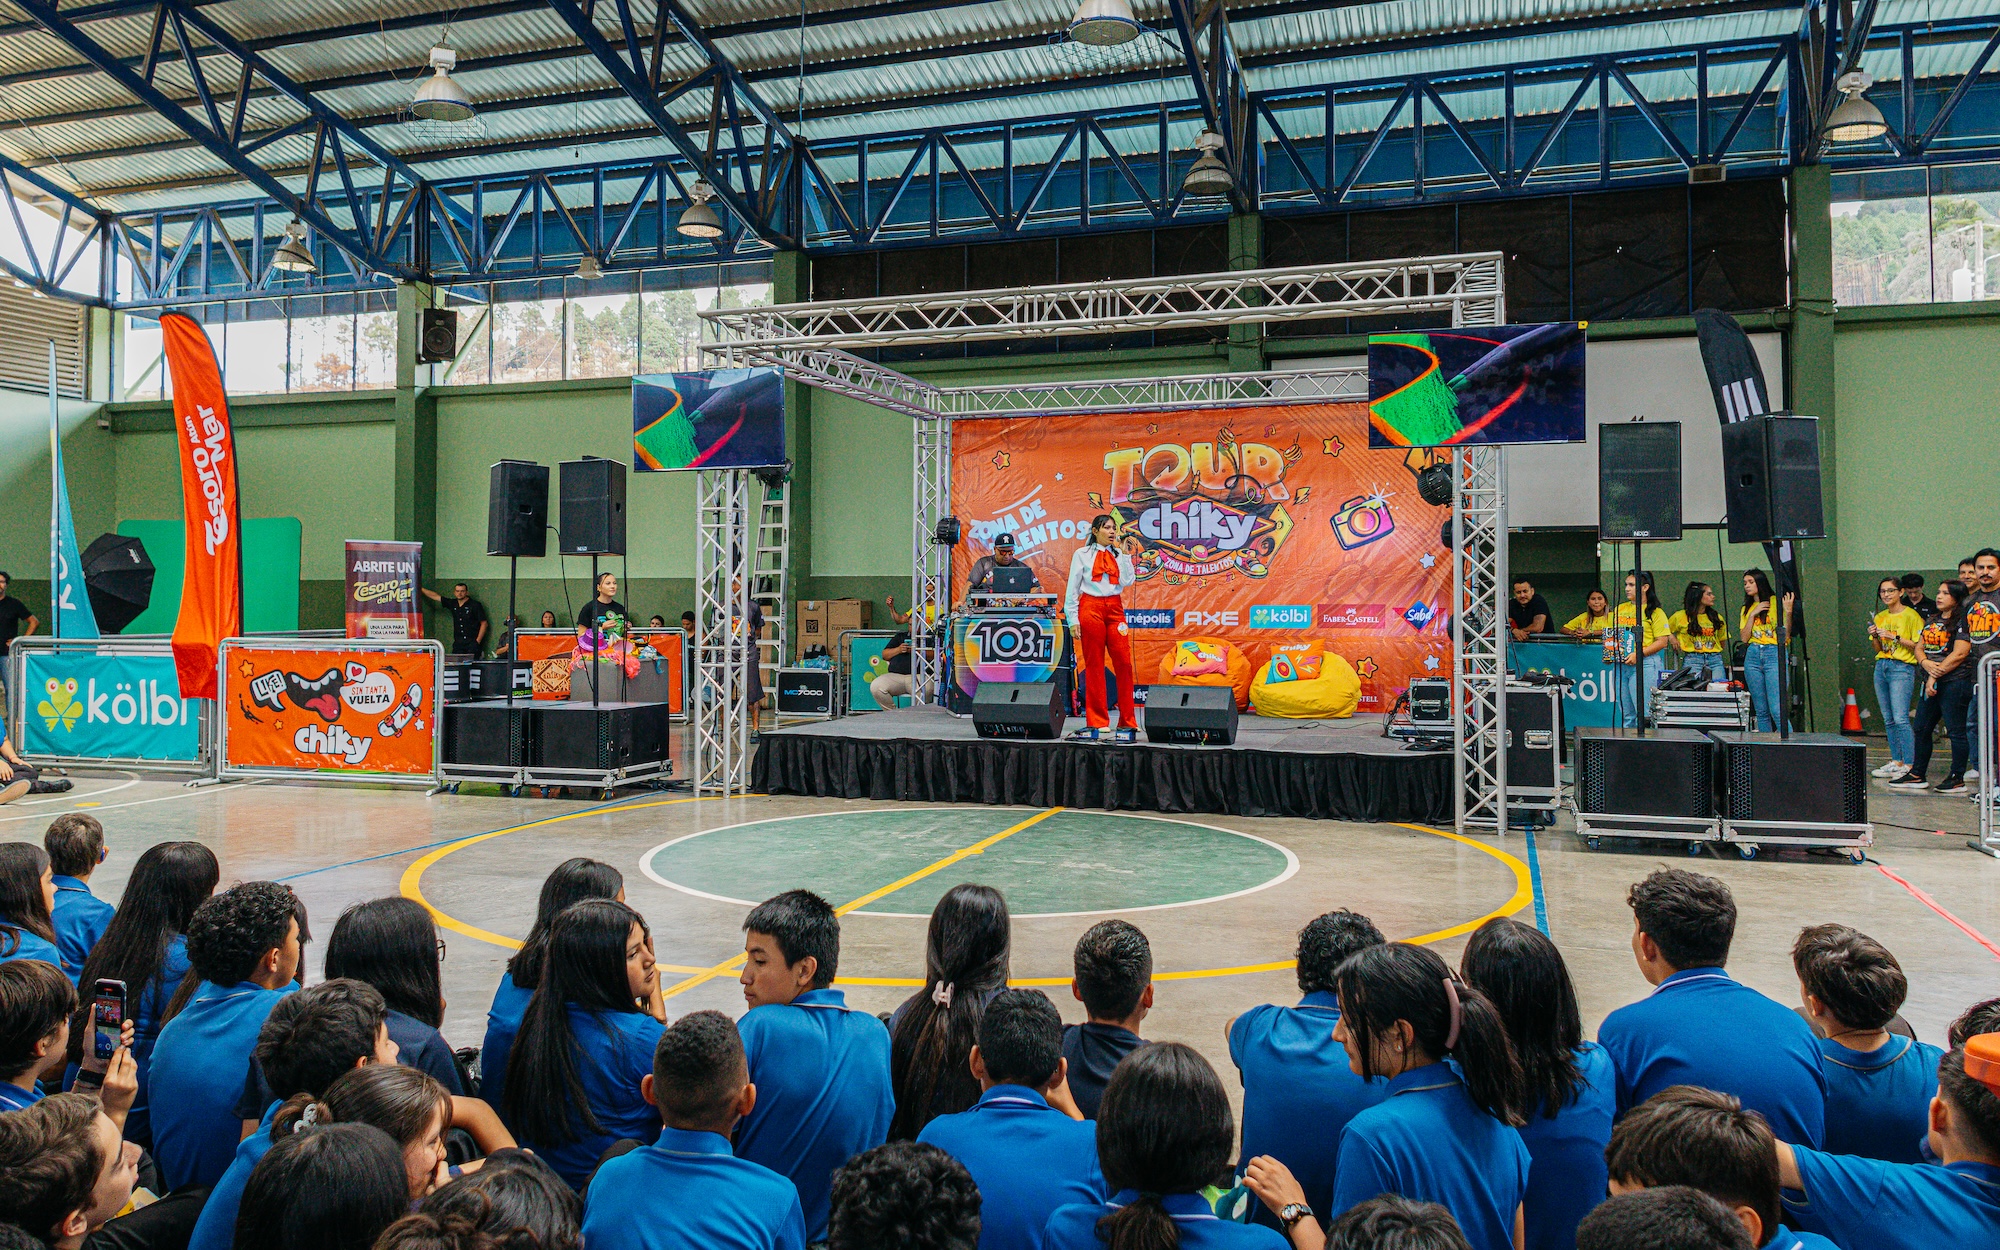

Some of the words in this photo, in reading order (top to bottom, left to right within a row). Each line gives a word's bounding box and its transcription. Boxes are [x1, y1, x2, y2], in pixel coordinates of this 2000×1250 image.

[196, 404, 226, 463] Mar
[1103, 441, 1291, 505] TOUR
[193, 447, 229, 556] Tesoro
[968, 513, 1020, 539] ZONA
[1018, 498, 1047, 526] DE
[1138, 500, 1257, 551] chiky
[989, 519, 1091, 557] LENTOS
[353, 560, 395, 573] ABRITE
[397, 561, 415, 574] UN
[1164, 557, 1183, 572] ZONA
[1185, 564, 1194, 574] DE
[1197, 556, 1235, 575] TALENTOS
[353, 579, 399, 602] Tesoro
[389, 587, 414, 603] Mar
[1125, 612, 1171, 626] inépolis
[1183, 610, 1240, 626] AXE
[1270, 608, 1308, 623] kölbi
[980, 625, 1044, 658] 103.1
[255, 673, 284, 697] LIKE!
[351, 687, 364, 695] SIN
[365, 685, 387, 695] TANTA
[87, 677, 188, 726] kölbi
[349, 694, 390, 705] VUELTA
[294, 724, 373, 764] chiky
